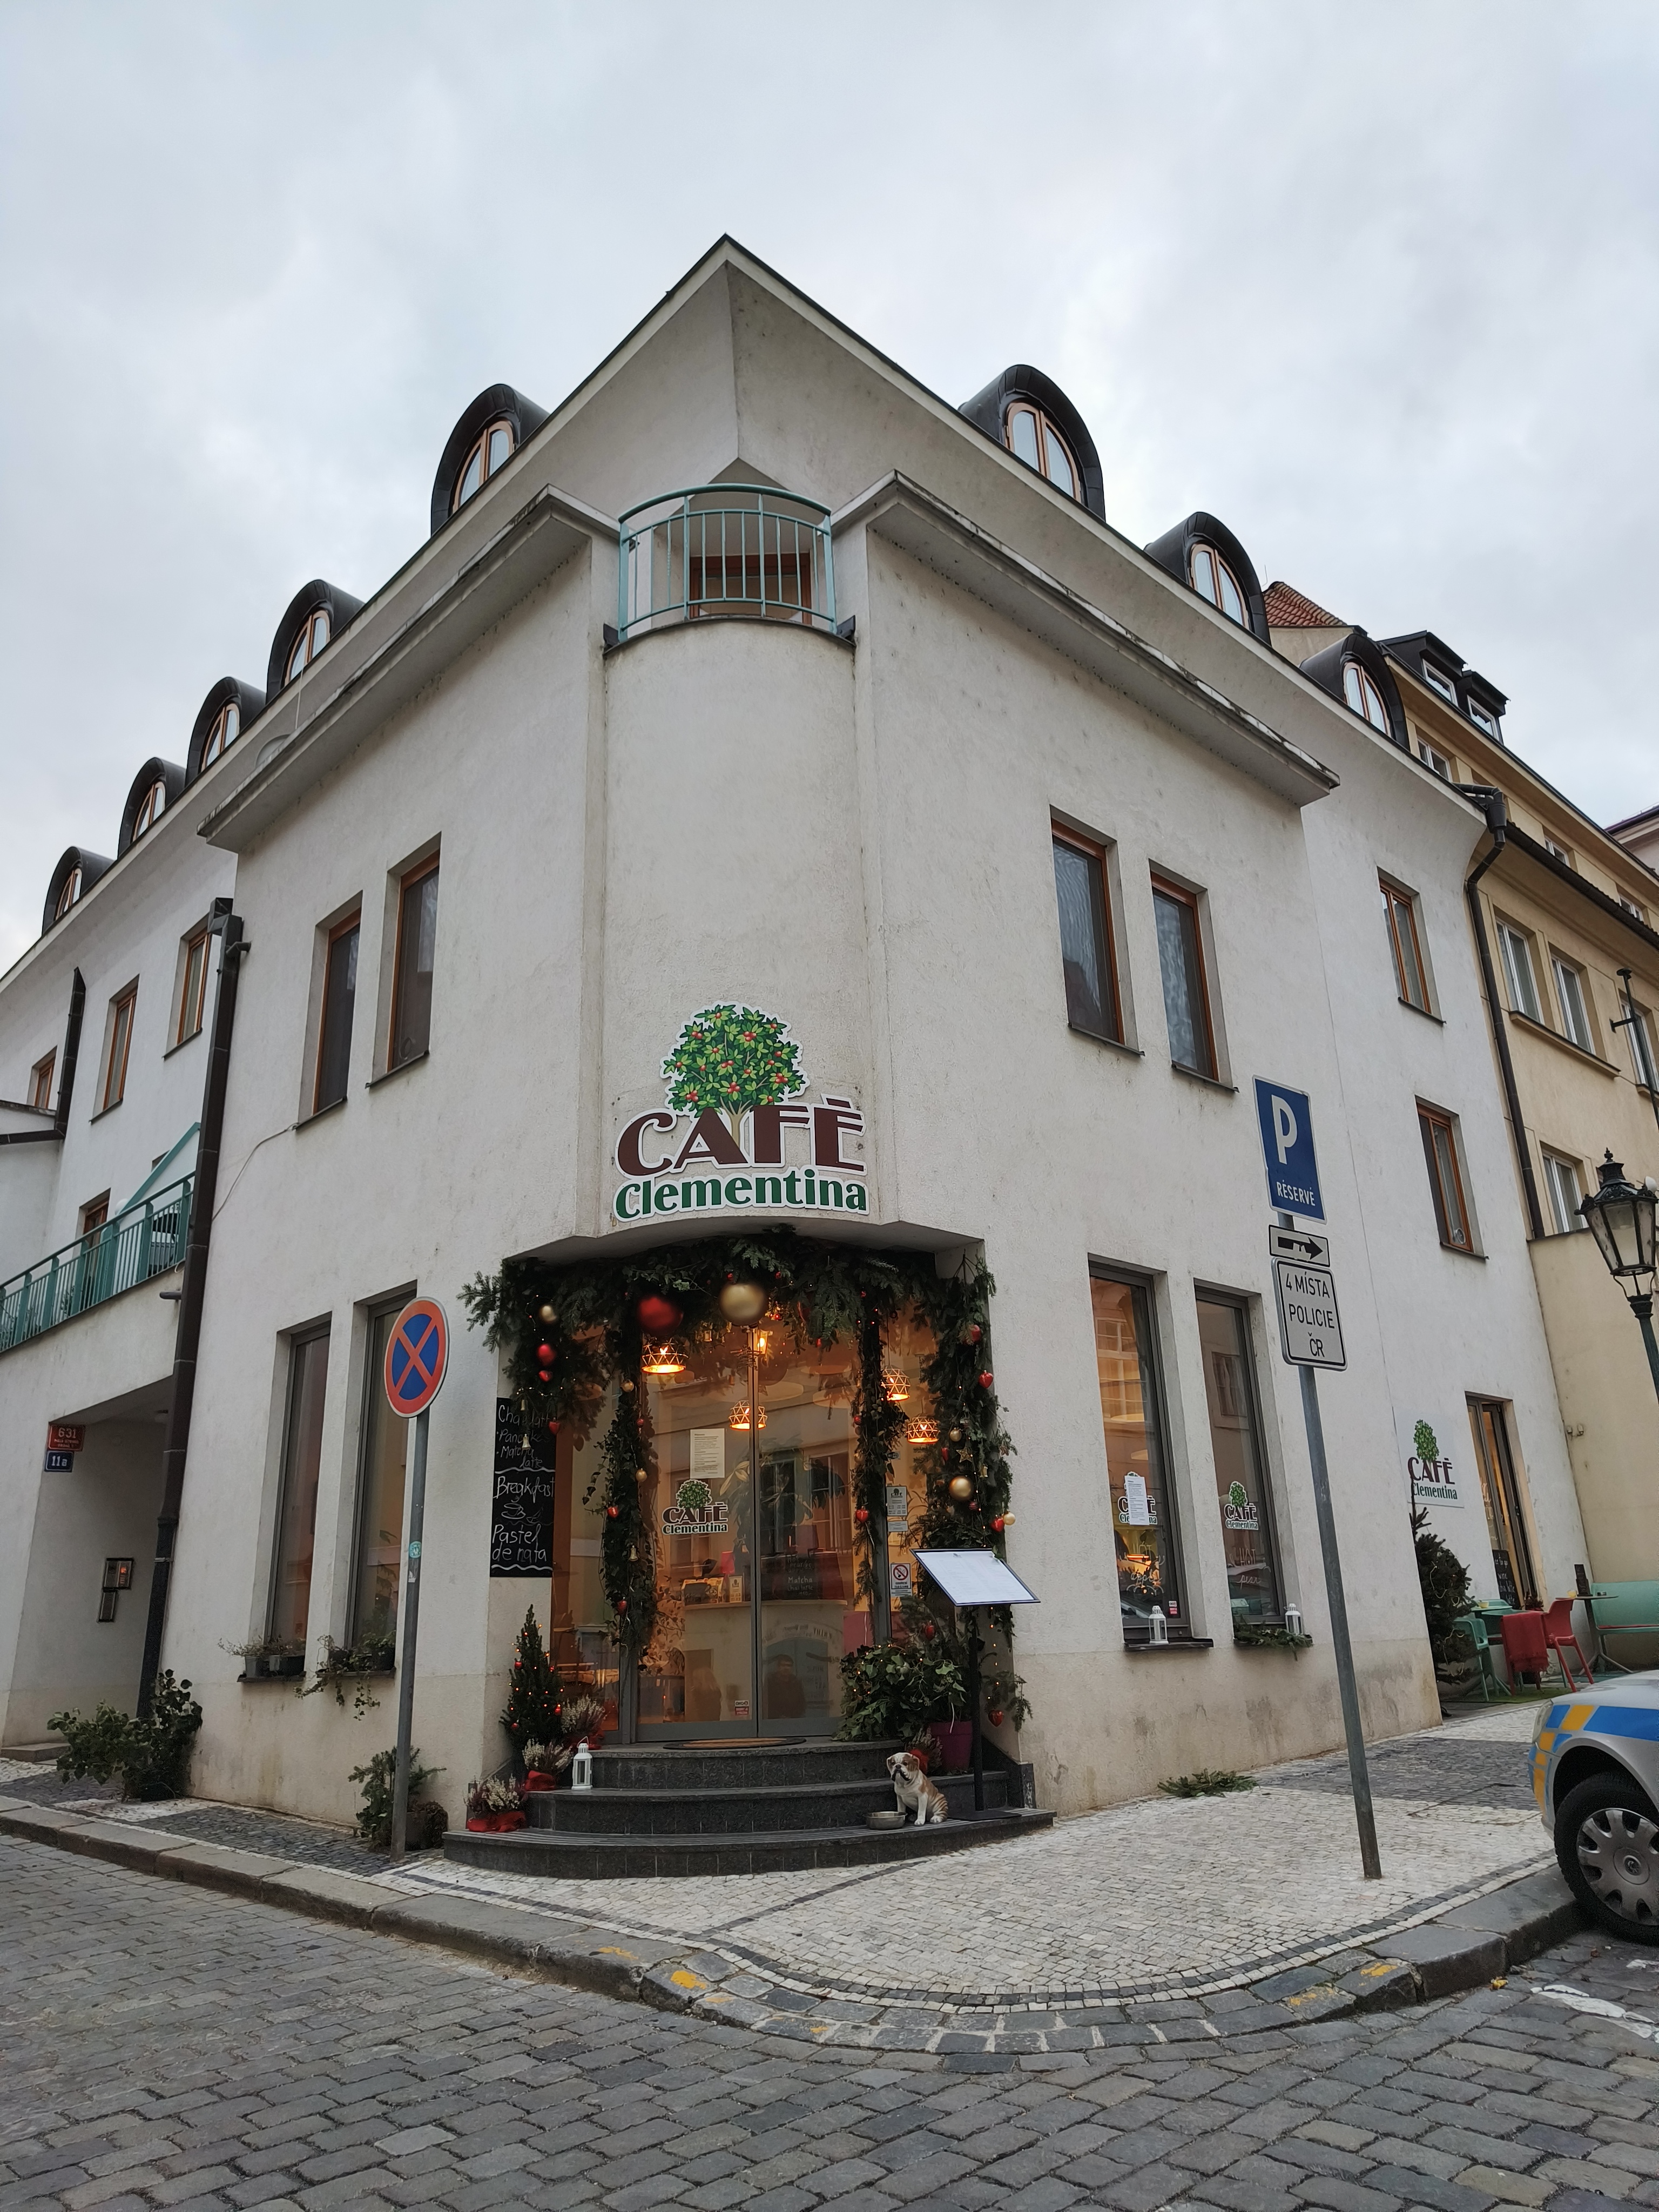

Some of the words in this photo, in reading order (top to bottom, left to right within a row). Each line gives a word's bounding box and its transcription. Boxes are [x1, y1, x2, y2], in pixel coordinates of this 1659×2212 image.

[618, 1097, 864, 1176] CAFÉ
[1272, 1095, 1297, 1164] P
[616, 1169, 866, 1219] Clementina
[1277, 1179, 1316, 1207] RÉSERVÉ
[1286, 1273, 1292, 1291] 4
[1295, 1271, 1330, 1298] MÍSTA
[1289, 1303, 1335, 1329] POLICIE
[1308, 1332, 1325, 1358] ČR
[58, 1427, 76, 1439] 631
[499, 1429, 549, 1444] Panck
[1408, 1457, 1455, 1485] CAFÉ
[493, 1476, 555, 1503] Breakfast
[1412, 1482, 1458, 1500] Clementina
[663, 1502, 727, 1523] CAFÉ
[1119, 1496, 1156, 1514] CÉ
[1225, 1504, 1257, 1520] CAFÉ
[492, 1523, 541, 1545] Pastel
[663, 1522, 727, 1534] Clementina
[1226, 1520, 1258, 1529] Clementina
[492, 1542, 512, 1561] de
[517, 1545, 547, 1563] nata
[788, 1575, 813, 1583] Matcha
